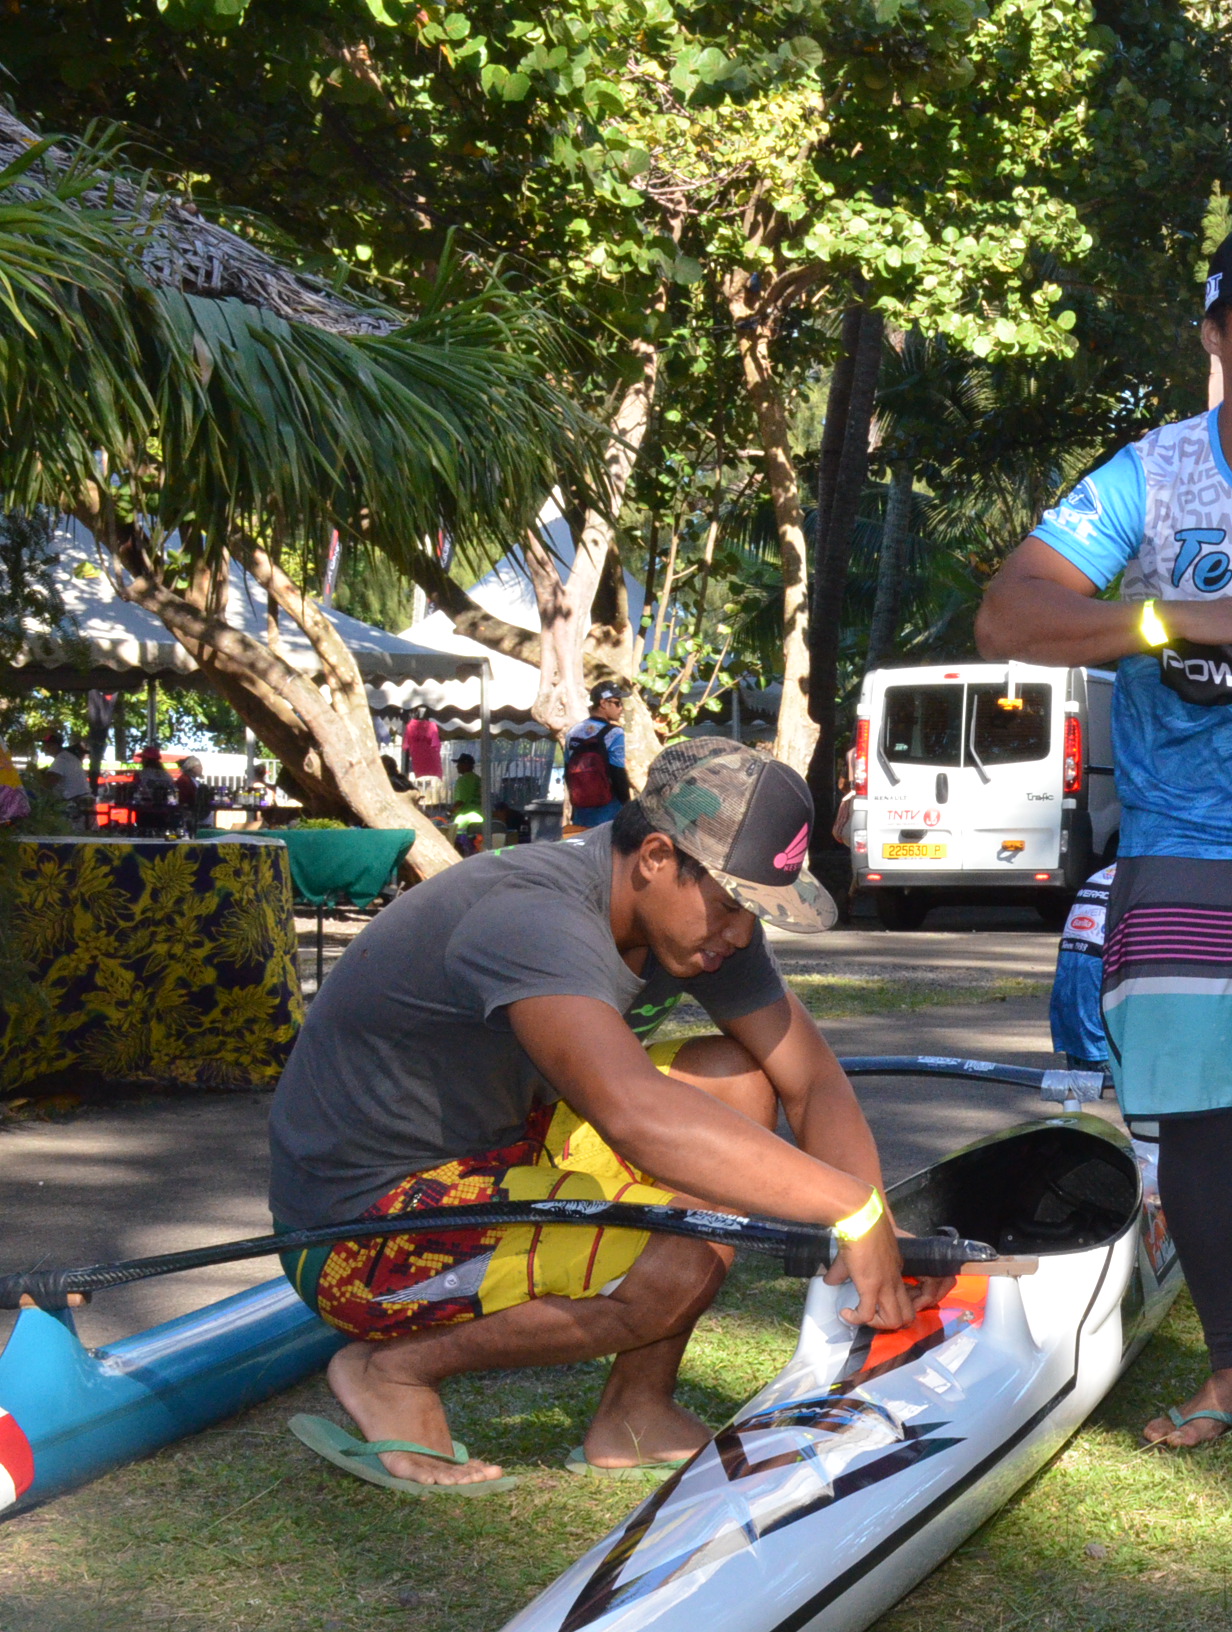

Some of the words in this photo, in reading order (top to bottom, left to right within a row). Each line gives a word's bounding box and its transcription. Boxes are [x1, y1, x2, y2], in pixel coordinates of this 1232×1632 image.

[1026, 792, 1055, 802] Trafic
[887, 809, 921, 820] TNTV
[888, 845, 928, 857] 225630
[934, 845, 941, 856] P
